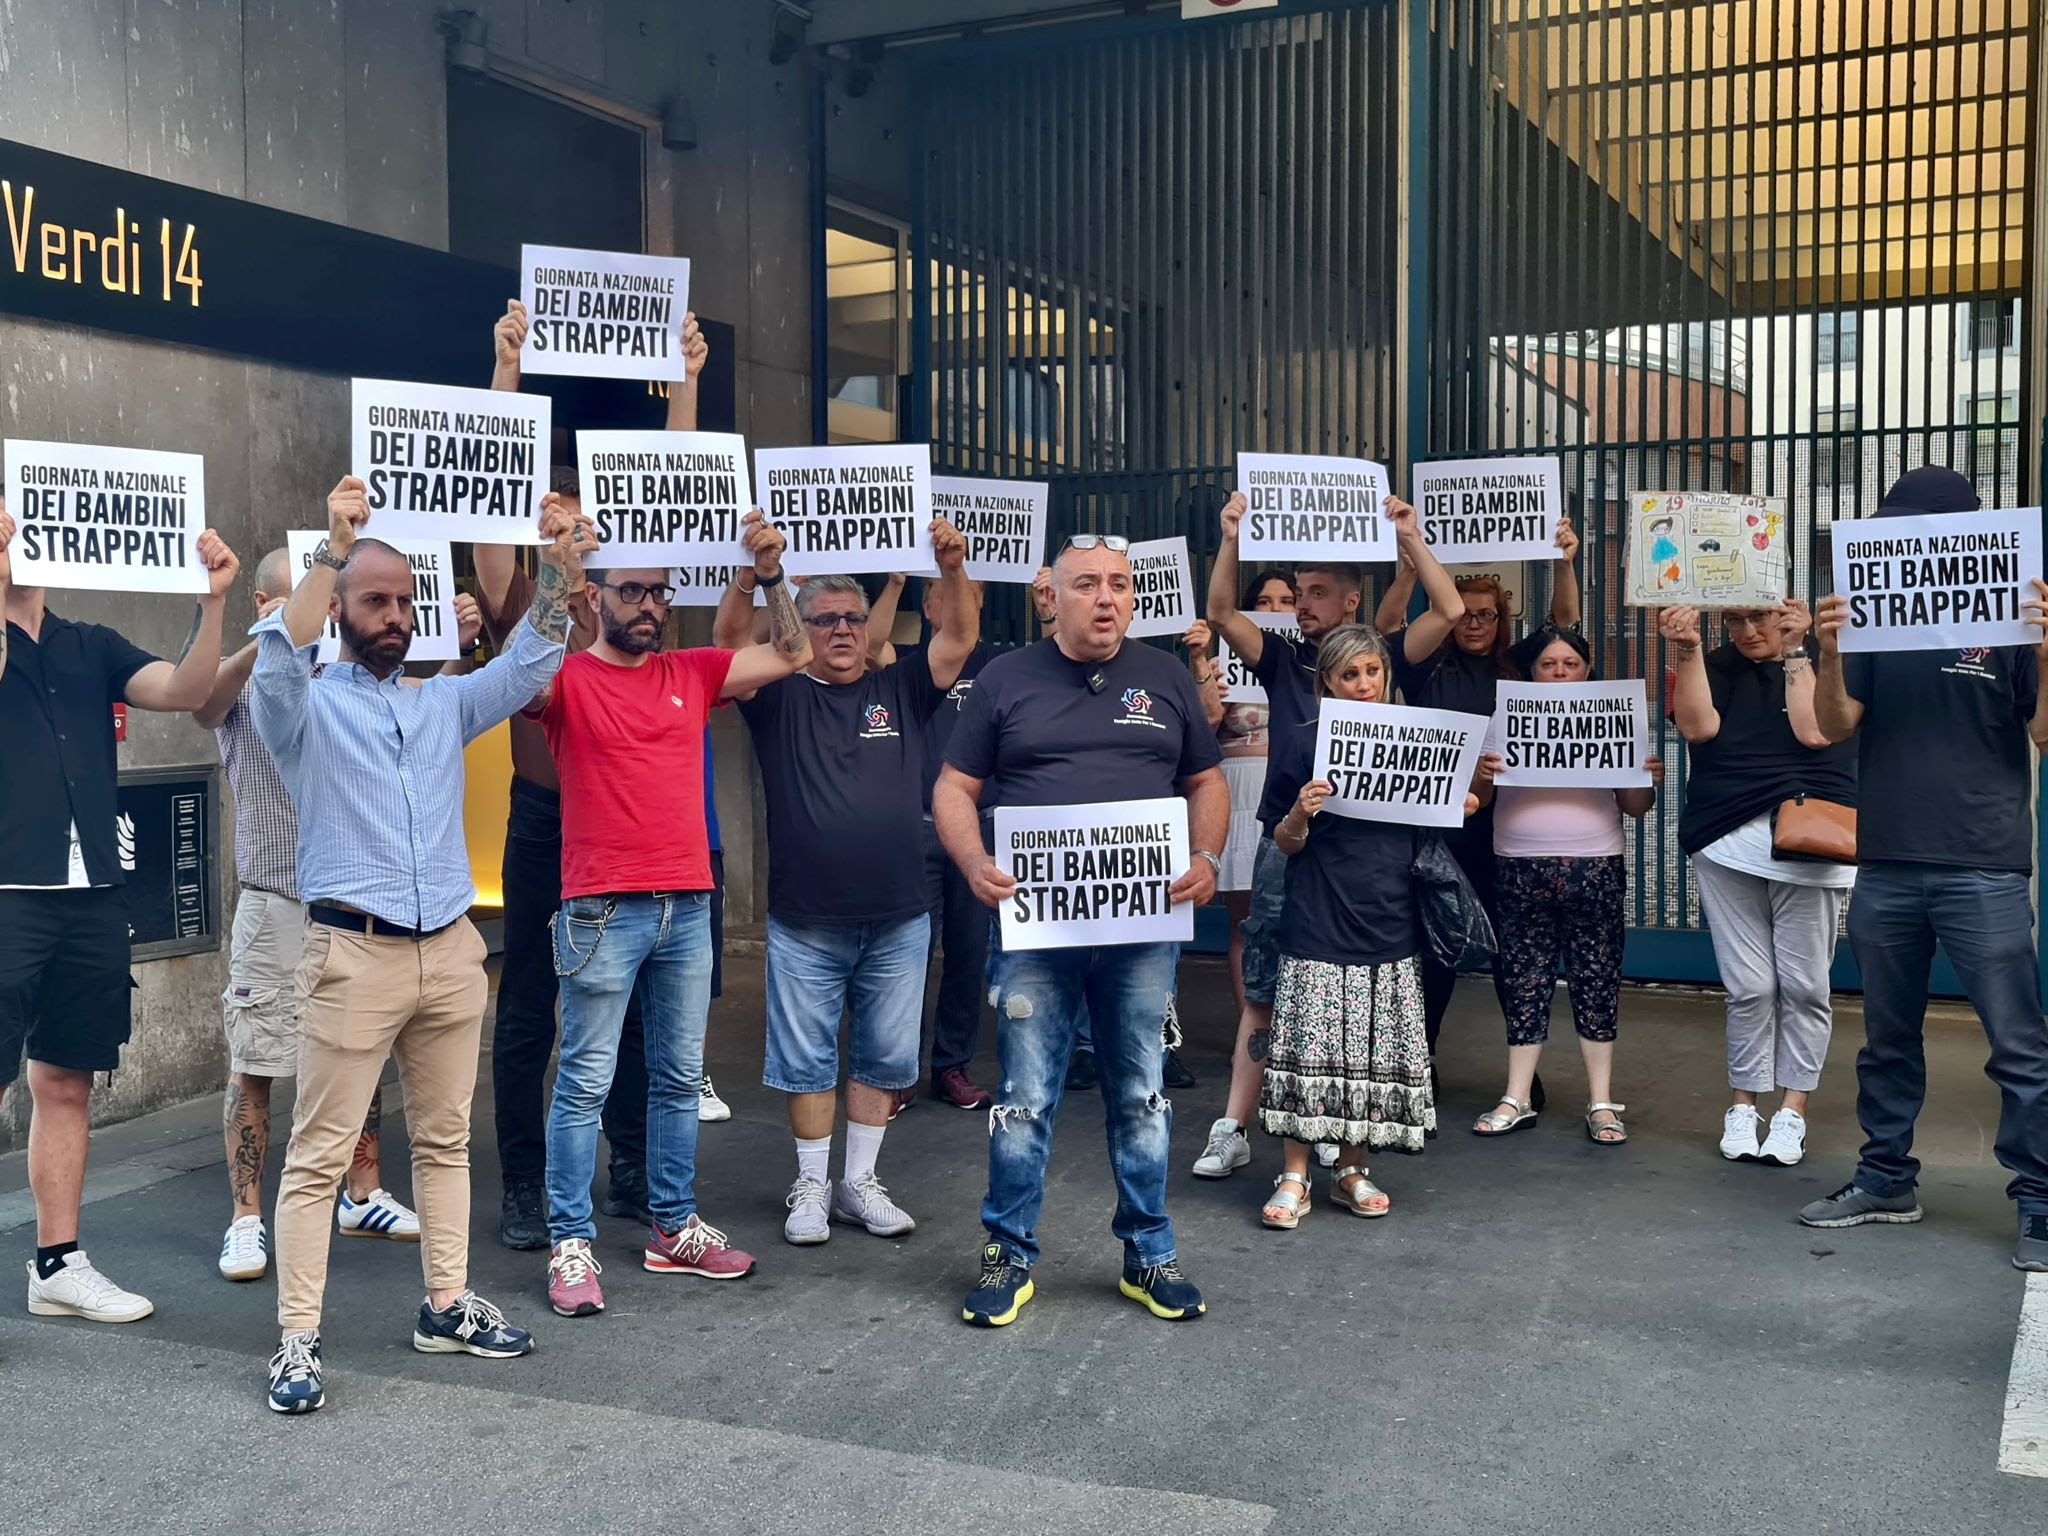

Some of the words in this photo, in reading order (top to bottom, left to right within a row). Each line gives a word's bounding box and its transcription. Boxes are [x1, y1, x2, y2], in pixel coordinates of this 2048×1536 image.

[2, 180, 140, 295] Verdi
[161, 218, 203, 307] 14
[535, 268, 598, 288] GIORNATA
[603, 273, 674, 294] NAZIONALE
[535, 288, 570, 317] DEI
[578, 291, 671, 324] BAMBINI
[533, 319, 667, 357] STRAPPATI
[369, 406, 449, 432] GIORNATA
[455, 413, 535, 439] NAZIONALE
[371, 431, 414, 467] DEI
[425, 435, 534, 475] BAMBINI
[592, 454, 661, 471] GIORNATA
[666, 454, 735, 472] NAZIONALE
[21, 465, 98, 488] GIORNATA
[105, 471, 186, 494] NAZIONALE
[595, 475, 633, 504] DEI
[642, 475, 736, 504] BAMBINI
[769, 468, 835, 486] GIORNATA
[840, 466, 914, 484] NAZIONALE
[1250, 471, 1307, 485] GIORNATA
[1311, 473, 1377, 488] NAZIONALE
[1424, 477, 1478, 492] GIORNATA
[1483, 475, 1545, 489] NAZIONALE
[23, 488, 65, 521] DEI
[76, 491, 185, 528] BAMBINI
[369, 470, 532, 517] STRAPPATI
[771, 489, 807, 517] DEI
[817, 486, 913, 515] BAMBINI
[932, 493, 971, 508] ORNATA
[975, 496, 1033, 511] NAZIONALE
[1251, 487, 1282, 511] DEI
[1291, 488, 1377, 513] BAMBINI
[1425, 494, 1454, 516] DEI
[1462, 490, 1544, 515] BAMBINI
[596, 508, 738, 543] STRAPPATI
[773, 517, 914, 552] STRAPPATI
[955, 511, 1031, 536] BAMBINI
[1251, 513, 1378, 542] STRAPPATI
[1425, 515, 1545, 545] STRAPPATI
[22, 524, 185, 567] STRAPPATI
[1847, 538, 1923, 559] GIORNATA
[1929, 532, 2019, 554] NAZIONALE
[1130, 554, 1178, 571] AZIONALE
[1849, 561, 1890, 591] DEI
[1901, 553, 2018, 588] BAMBINI
[1133, 569, 1179, 594] MBINI
[1850, 587, 2019, 628] STRAPPATI
[1507, 699, 1565, 713] GIORNATA
[1570, 698, 1633, 713] NAZIONALE
[1331, 720, 1393, 740] GIORNATA
[1398, 727, 1468, 746] NAZIONALE
[1507, 715, 1538, 739] DEI
[1547, 715, 1633, 739] BAMBINI
[1329, 739, 1365, 767] DEI
[1371, 743, 1461, 772] BAMBINI
[1506, 741, 1634, 768] STRAPPATI
[1327, 769, 1453, 805] STRAPPATI
[1011, 829, 1085, 849] GIORNATA
[1091, 823, 1170, 846] NAZIONALE
[1013, 852, 1053, 883] DEI
[1064, 845, 1171, 881] BAMBINI
[1013, 880, 1171, 923] STRAPPATI
